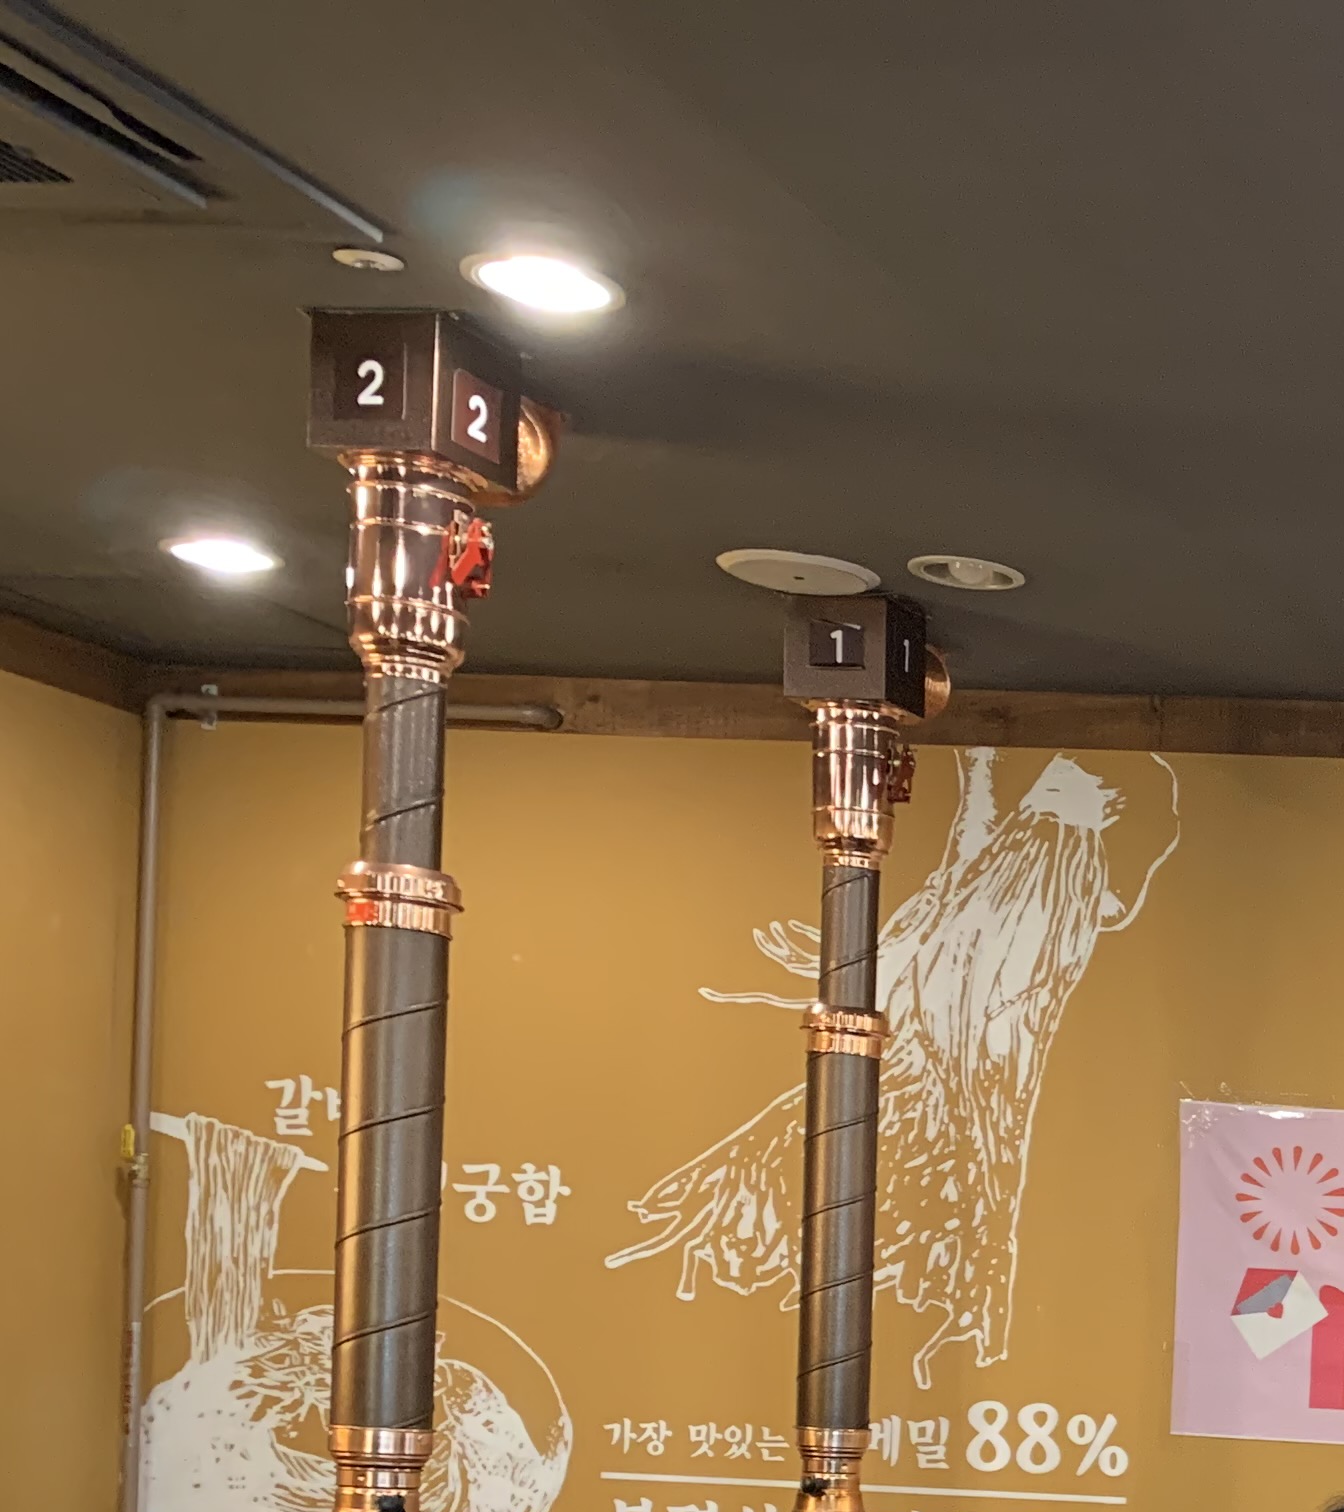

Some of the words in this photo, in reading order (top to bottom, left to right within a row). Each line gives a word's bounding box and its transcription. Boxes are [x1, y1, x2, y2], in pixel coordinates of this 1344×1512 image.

[355, 359, 386, 406] 2
[466, 395, 489, 443] 2
[829, 629, 844, 664] 1
[451, 1162, 572, 1226] 궁합
[603, 1417, 673, 1456] 가장
[689, 1421, 790, 1462] 맛있는
[965, 1399, 1129, 1478] 88%
